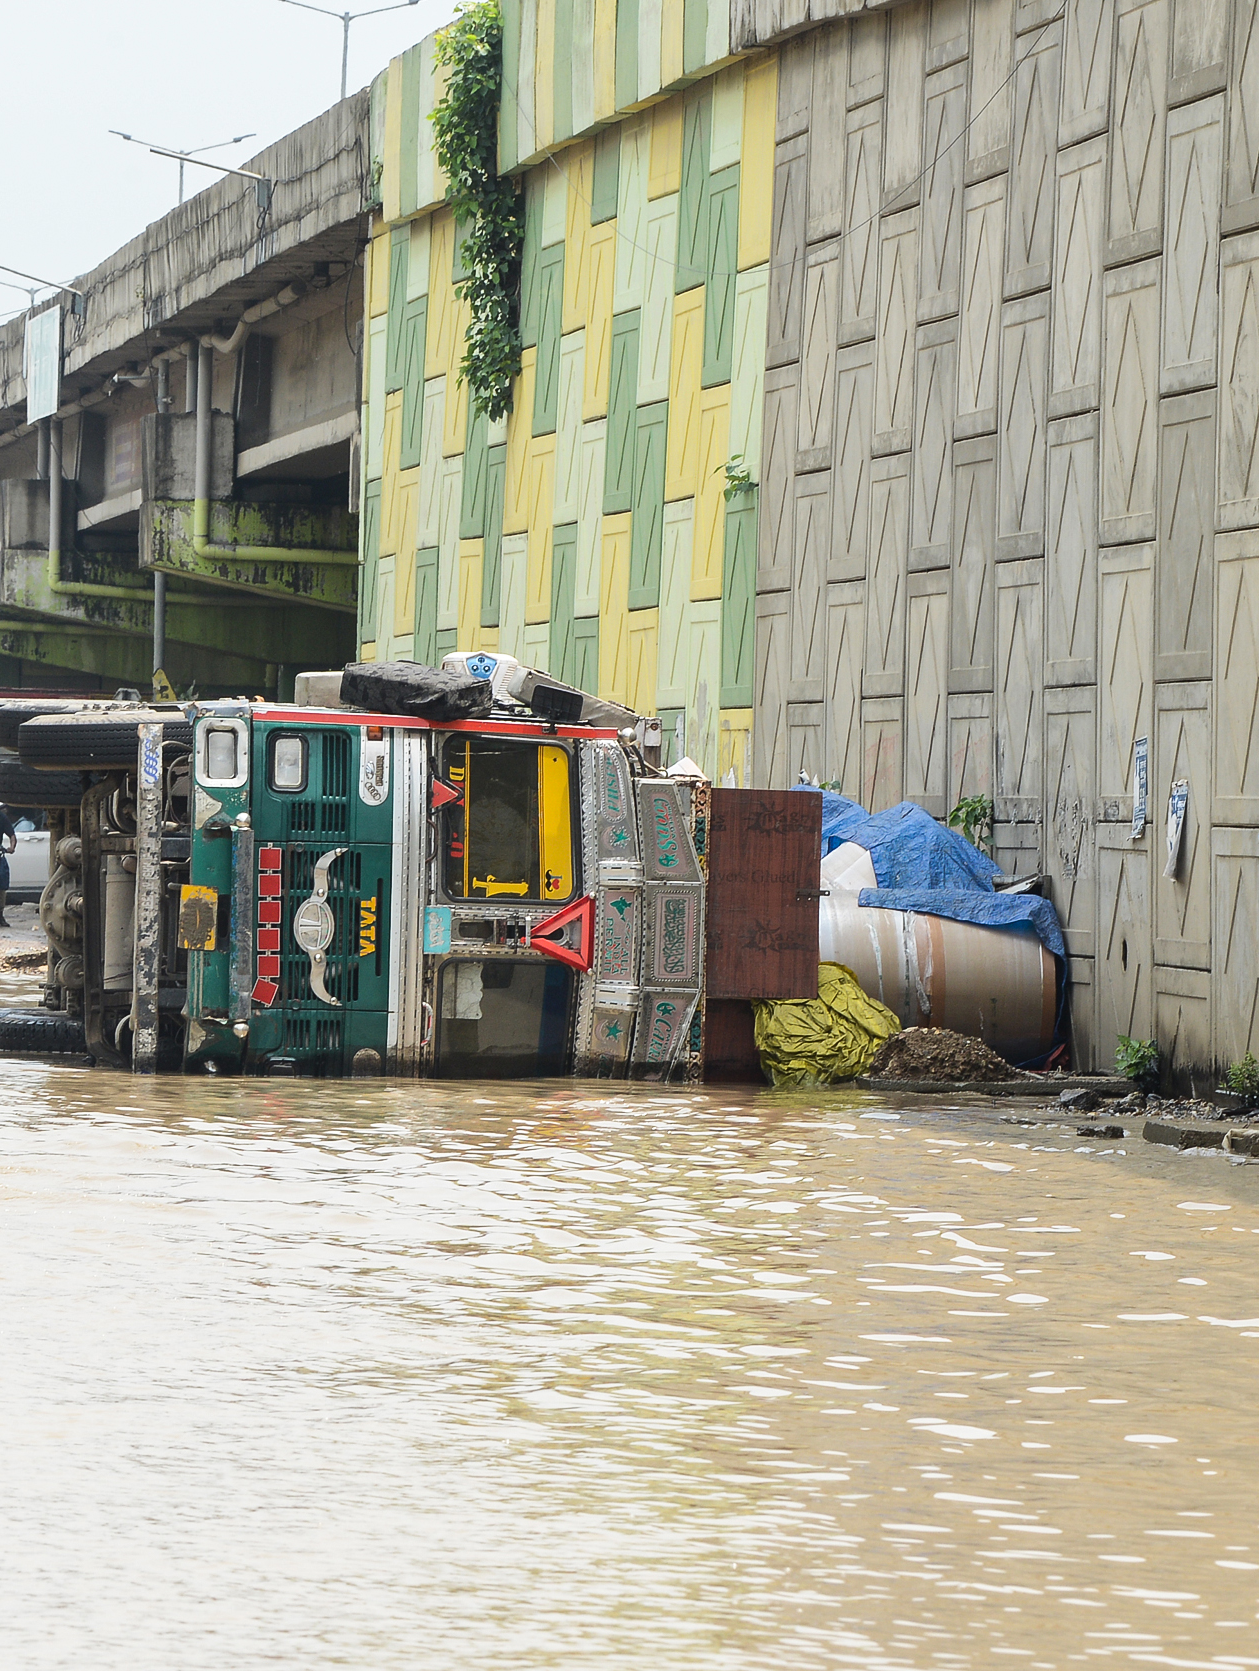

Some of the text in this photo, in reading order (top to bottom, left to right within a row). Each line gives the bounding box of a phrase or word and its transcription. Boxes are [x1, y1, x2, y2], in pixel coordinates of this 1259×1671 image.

[359, 896, 376, 957] TATA
[604, 917, 614, 973] PERMIT
[612, 936, 622, 975] INDIA
[620, 948, 629, 975] ALL
